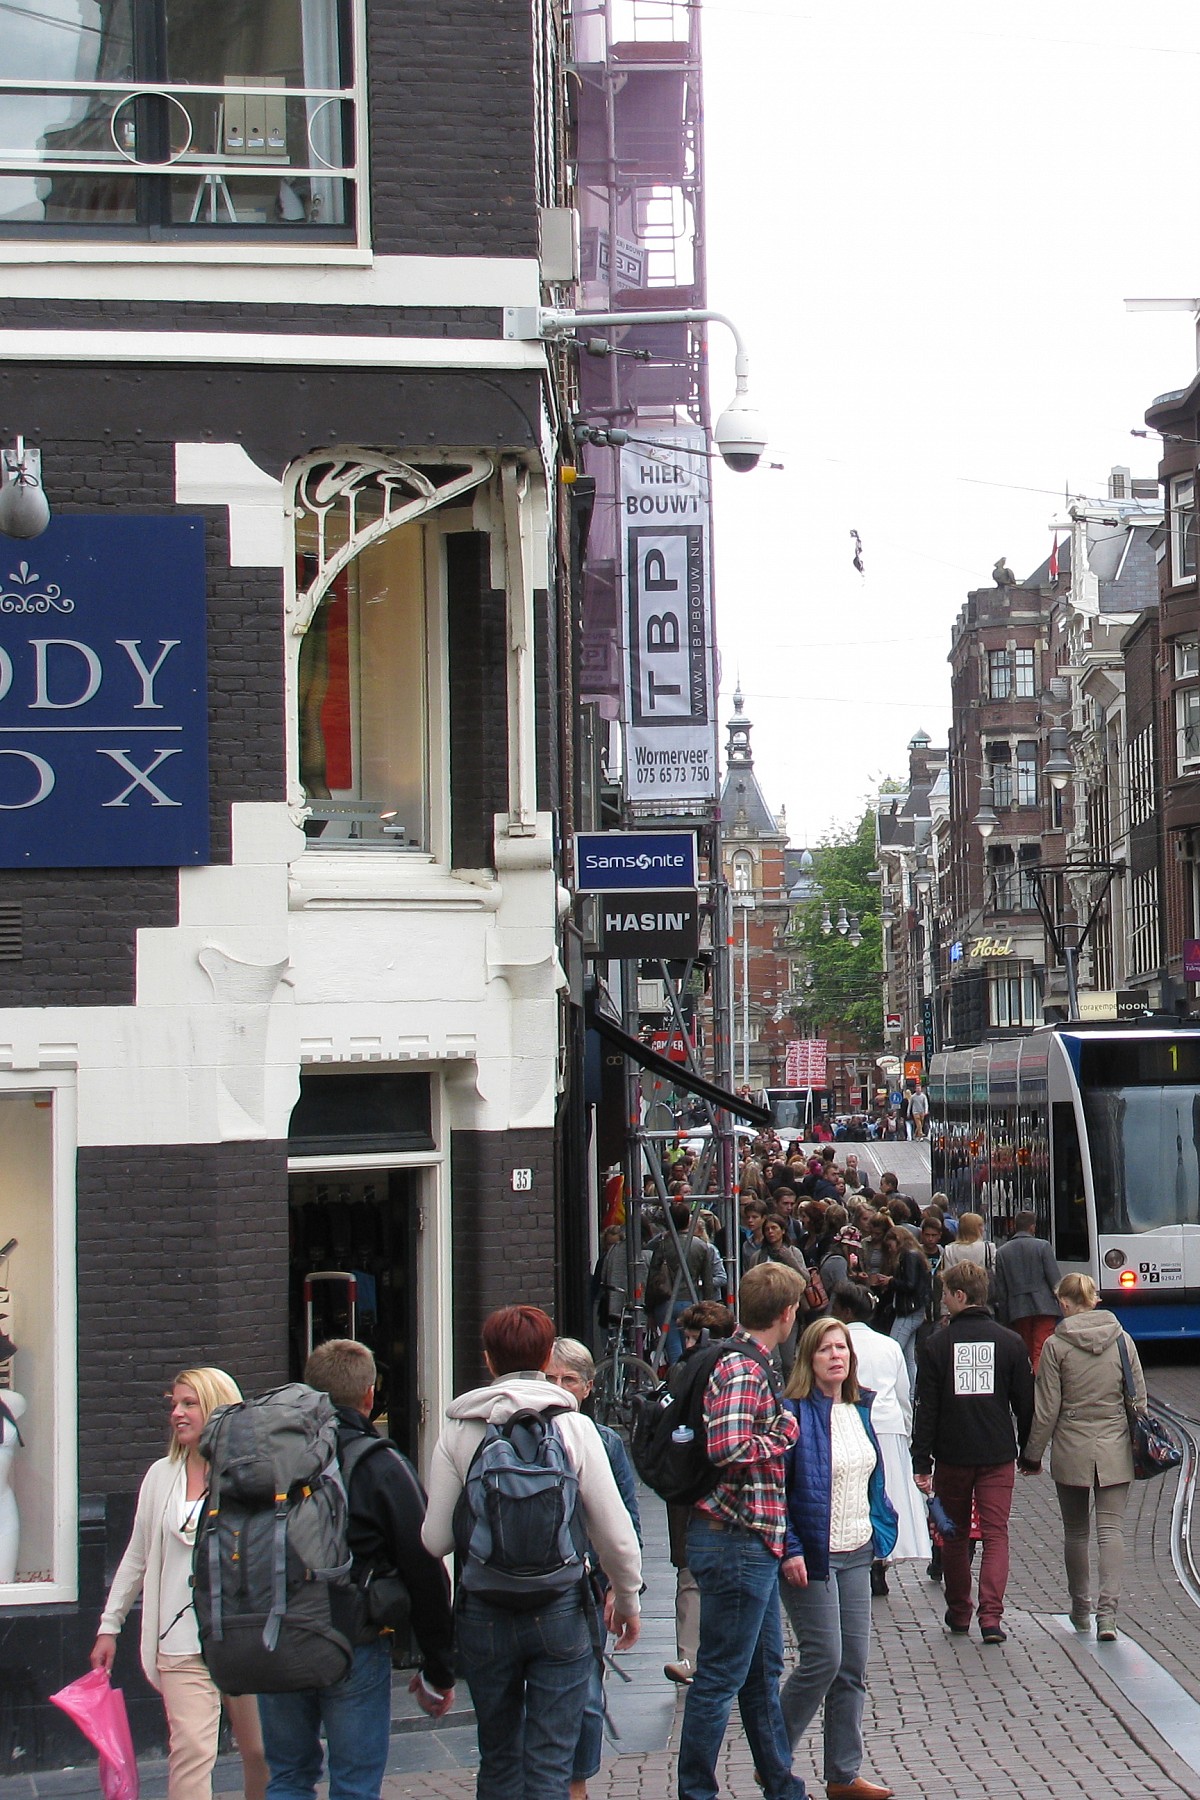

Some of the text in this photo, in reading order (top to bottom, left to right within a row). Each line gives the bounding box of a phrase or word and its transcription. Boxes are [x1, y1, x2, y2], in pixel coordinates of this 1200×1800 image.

[640, 465, 686, 485] HIER
[626, 494, 701, 515] BOUWT
[644, 547, 682, 711] TBP
[690, 535, 704, 717] WWW.TBPBOUW.NL
[0, 638, 182, 710] DY
[635, 746, 709, 766] Wormerveer
[636, 767, 656, 784] 075
[690, 766, 710, 782] 750
[585, 853, 685, 871] Samsonite
[970, 935, 1014, 958] Hotel
[1118, 1002, 1148, 1011] NOON
[651, 1040, 684, 1053] CAMER
[1168, 1044, 1178, 1072] 1
[516, 1170, 528, 1189] 35
